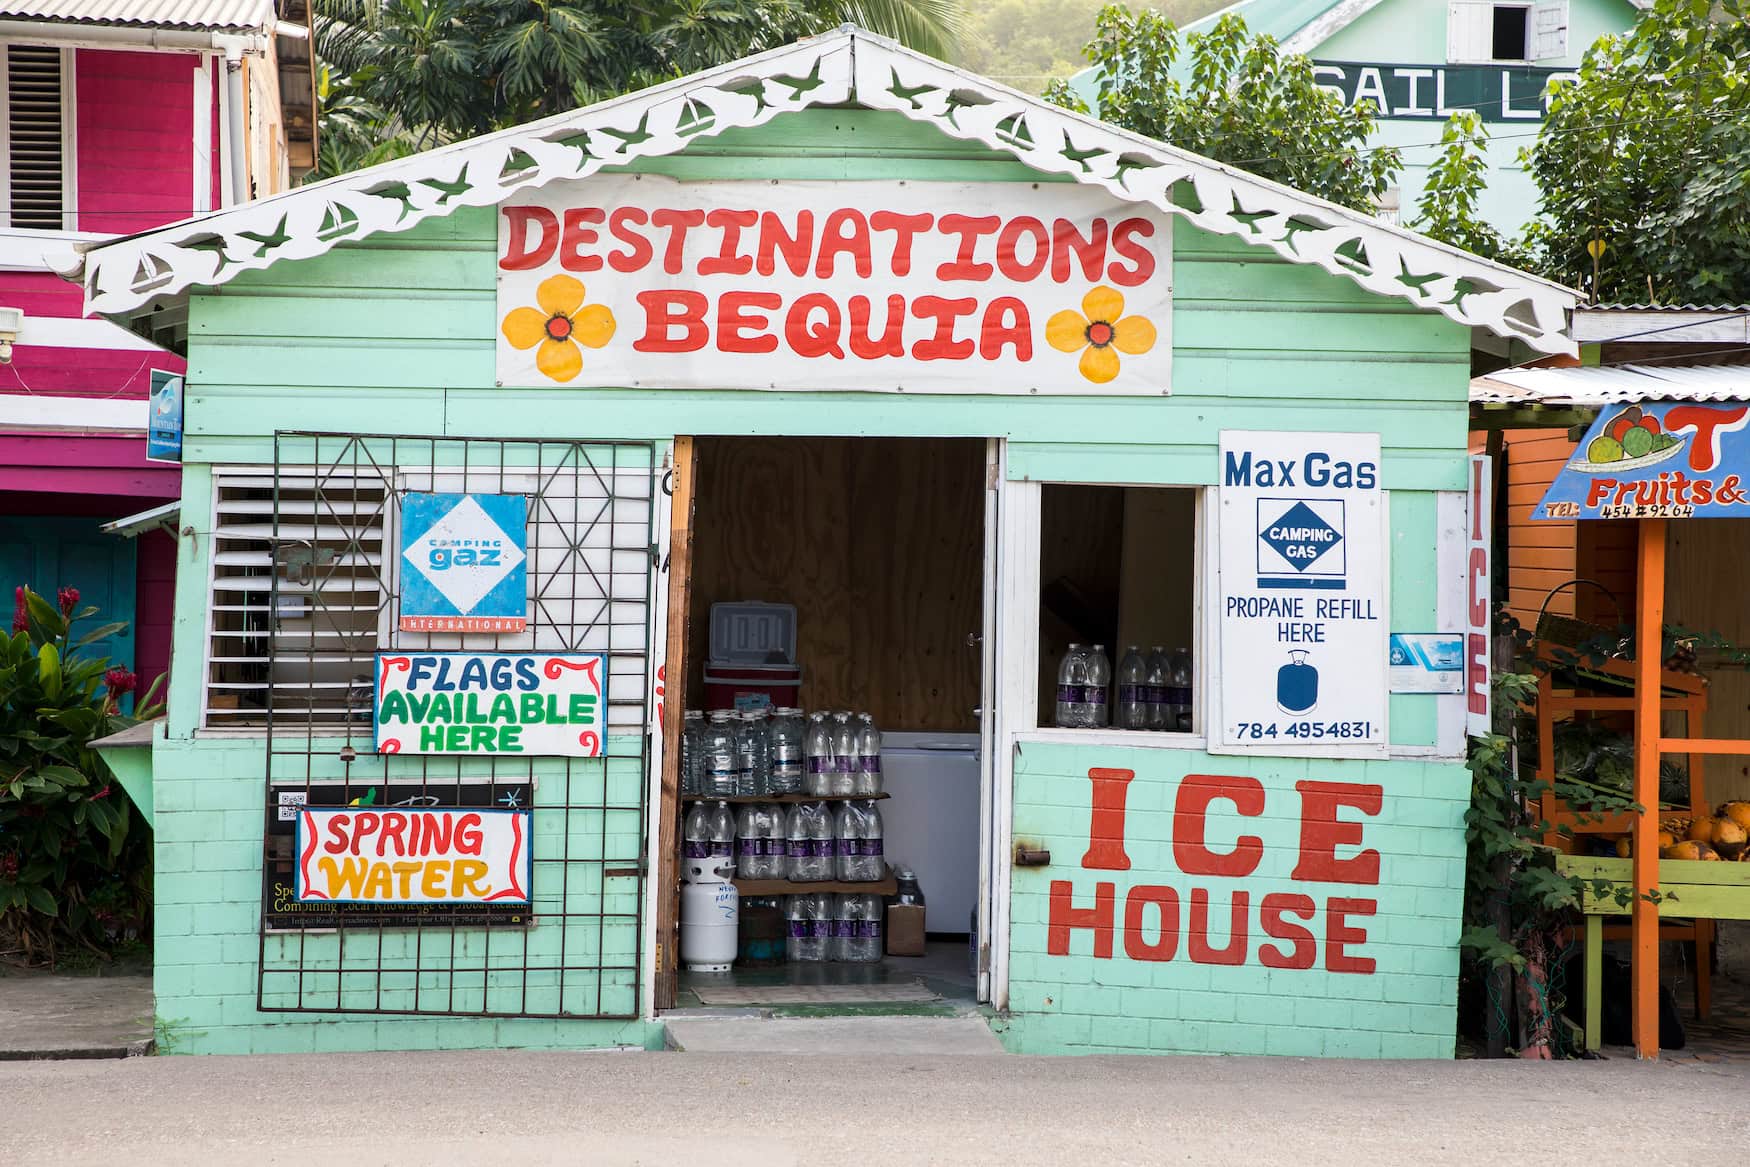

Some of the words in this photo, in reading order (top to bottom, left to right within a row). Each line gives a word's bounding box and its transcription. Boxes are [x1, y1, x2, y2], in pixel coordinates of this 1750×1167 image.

[499, 206, 1155, 287] DESTINATIONS
[633, 290, 1033, 362] BEQUIA
[1225, 451, 1297, 488] Max
[1303, 452, 1376, 489] Gas
[428, 539, 502, 548] CAMPING
[1269, 526, 1334, 543] CAMPING
[1286, 545, 1318, 559] GAS
[428, 548, 502, 571] gaz
[1468, 460, 1487, 715] ICE
[402, 618, 522, 630] INTERNATIONAL
[1226, 596, 1304, 618] PROPANE
[1316, 598, 1378, 620] REFILL
[1278, 622, 1326, 643] HERE
[406, 657, 540, 692] FLAGS
[379, 689, 598, 725] AVAILABLE
[419, 725, 525, 753] HERE
[1237, 721, 1279, 739] 784
[1284, 721, 1371, 739] 4954831
[323, 812, 484, 857] SPRING
[1081, 767, 1384, 885] ICE
[317, 855, 492, 900] WATER
[1048, 880, 1378, 975] HOUSE
